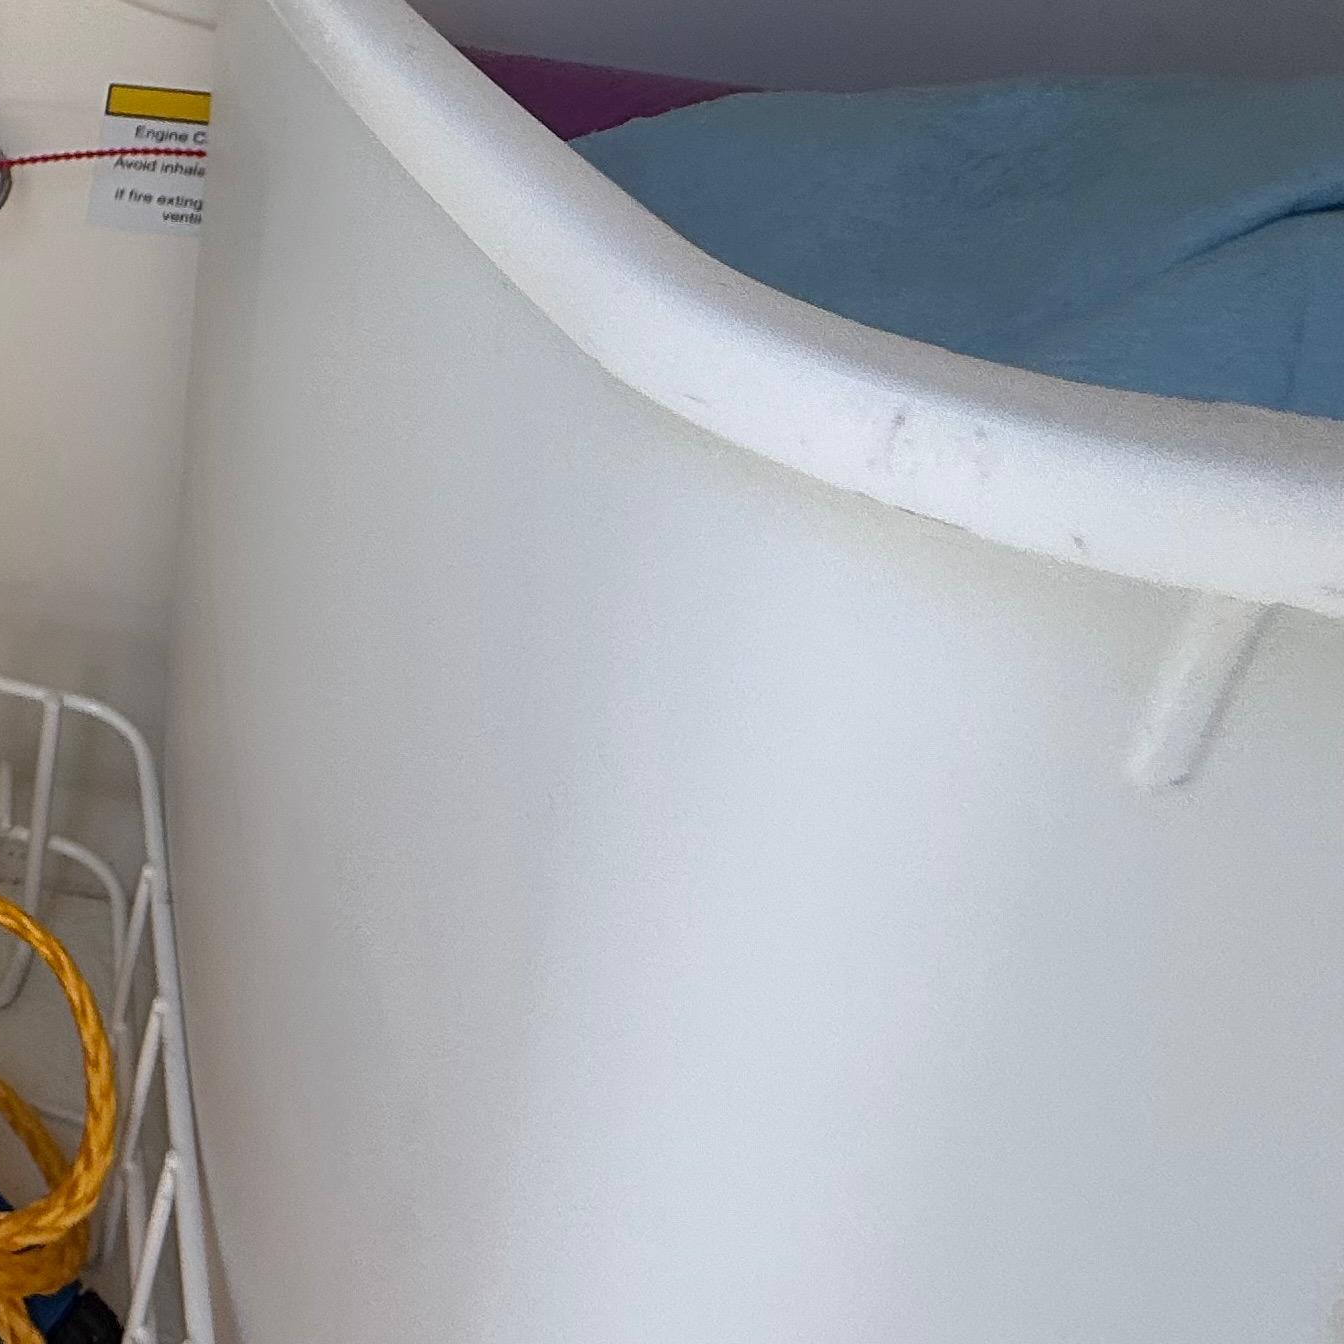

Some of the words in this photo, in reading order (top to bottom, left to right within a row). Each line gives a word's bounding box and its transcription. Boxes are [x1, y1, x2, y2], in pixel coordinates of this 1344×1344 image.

[135, 124, 188, 143] Engine
[113, 157, 158, 173] Avoid
[128, 189, 153, 203] fire
